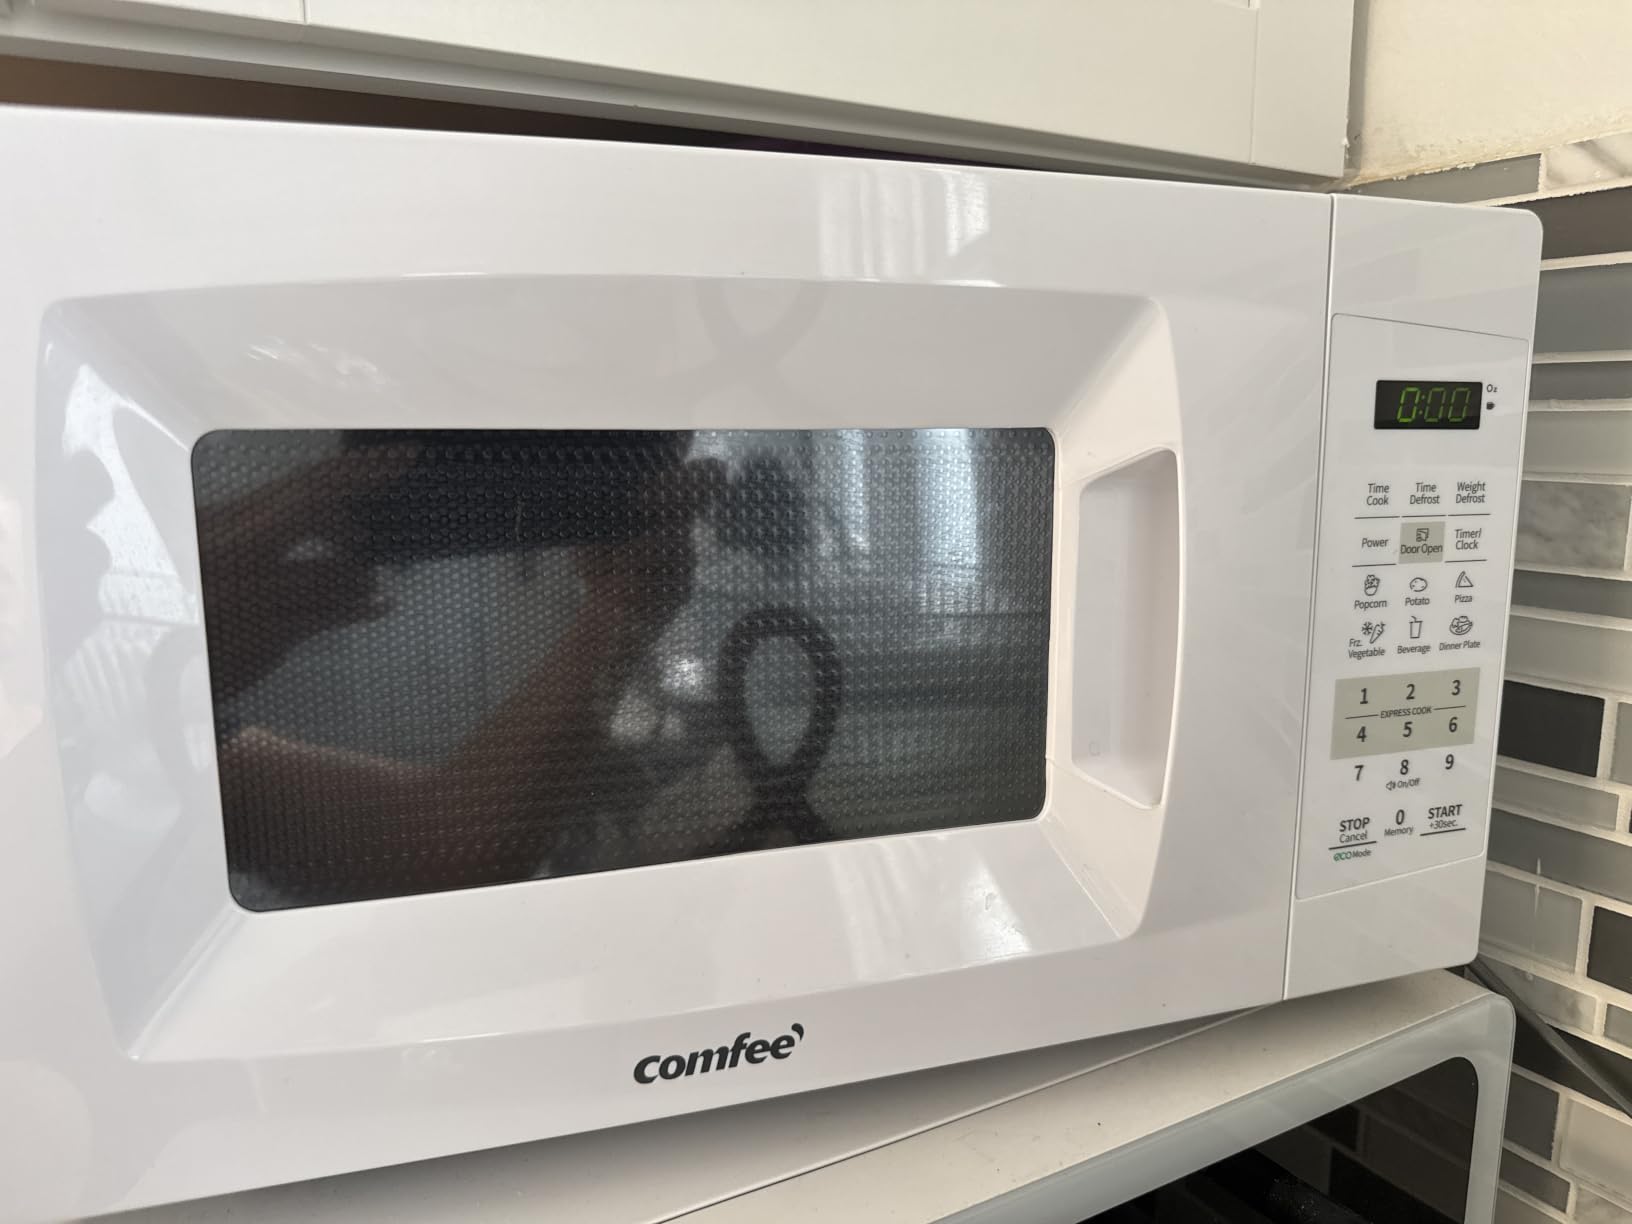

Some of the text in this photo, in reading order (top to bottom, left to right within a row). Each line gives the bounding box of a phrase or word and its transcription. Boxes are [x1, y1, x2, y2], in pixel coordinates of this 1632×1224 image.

[1397, 387, 1471, 422] 0:00
[1368, 483, 1389, 493] Time
[1416, 483, 1437, 493] Time
[1457, 482, 1486, 494] Weight
[1367, 495, 1389, 505] Cook
[1410, 494, 1440, 504] Defrost
[1456, 493, 1485, 503] Defrost
[1362, 538, 1389, 548] Power
[1456, 540, 1478, 550] Clock
[1401, 544, 1443, 555] Door Open
[1405, 597, 1430, 606] Potato
[1455, 595, 1473, 603] Pizza
[1354, 600, 1387, 611] Popcorn
[1398, 645, 1430, 654] Beverage
[1439, 640, 1480, 650] Dinner Plate
[1348, 648, 1385, 660] Vegetable
[1406, 684, 1415, 700] 2
[1451, 680, 1461, 695] 3
[1360, 688, 1368, 704] 1
[1380, 706, 1432, 718] EXPRESS COOK
[1403, 721, 1413, 738] 5
[1449, 717, 1458, 733] 6
[1356, 726, 1366, 742] 4
[1400, 759, 1408, 775] 8
[1445, 754, 1454, 770] 9
[1354, 765, 1364, 781] 7
[1397, 778, 1420, 788] On/Off
[1396, 809, 1404, 825] 0
[1428, 804, 1462, 819] START
[1339, 817, 1370, 832] STOP
[1384, 827, 1414, 836] Memory
[1339, 832, 1368, 843] Cancel
